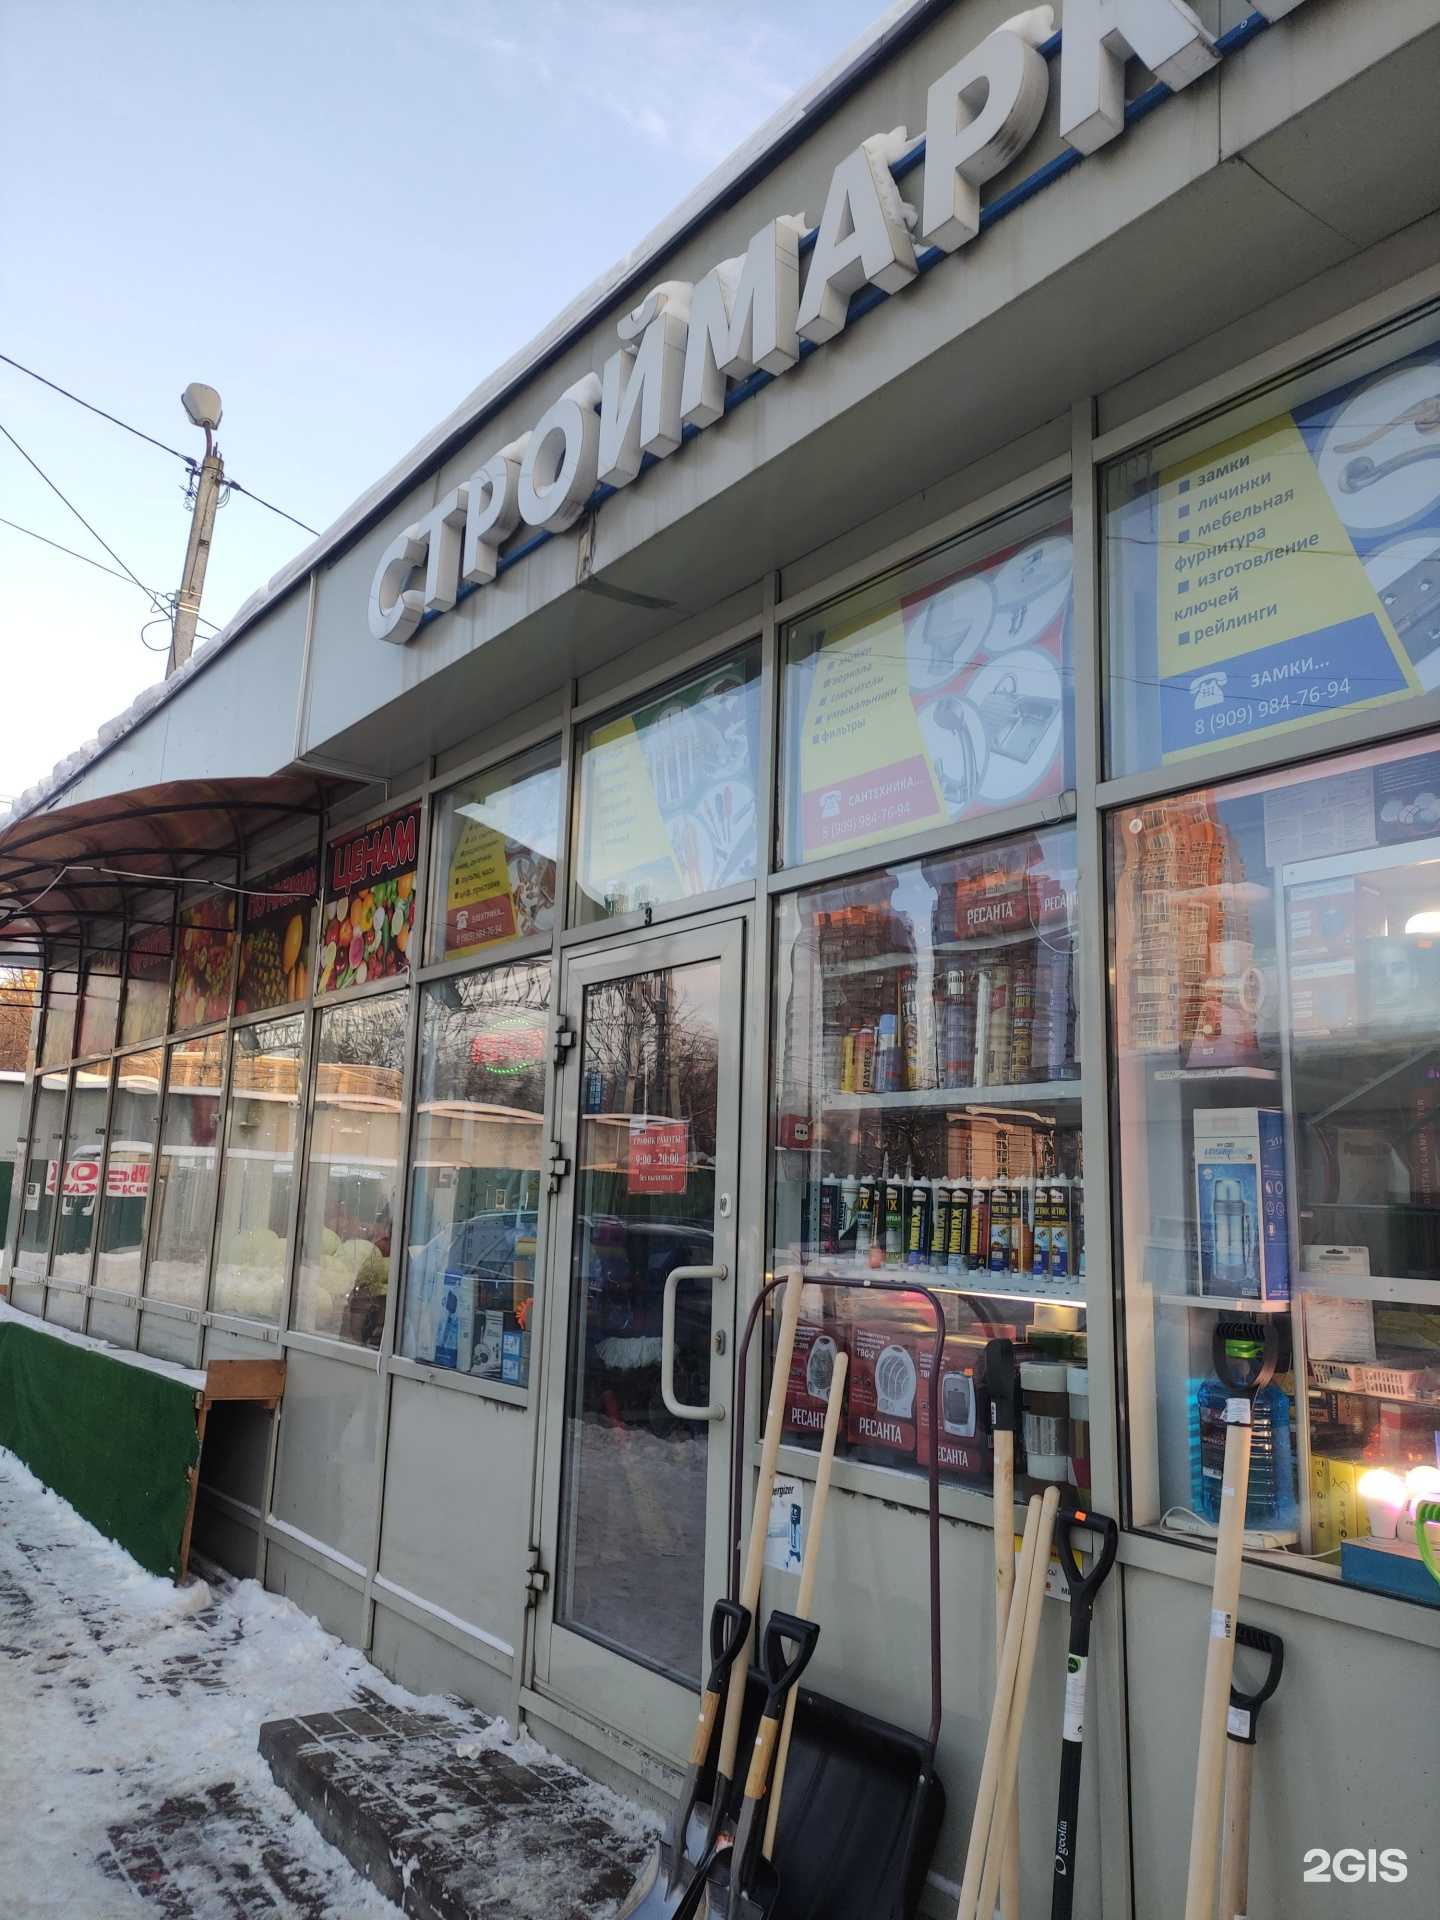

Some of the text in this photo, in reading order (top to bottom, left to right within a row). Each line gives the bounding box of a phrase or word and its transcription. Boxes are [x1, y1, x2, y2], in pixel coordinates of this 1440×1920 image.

[368, 0, 1306, 645] СТРОЙМАРК
[1198, 455, 1250, 486] замки
[1197, 472, 1271, 512] личинки
[1198, 489, 1294, 536] мебельная
[1174, 527, 1266, 573] фурнитура
[1198, 533, 1320, 587] изготовление
[1174, 585, 1239, 622] ключей
[1194, 603, 1278, 644] рейлинги
[1194, 677, 1351, 735] 8 (909) 984-76-94
[821, 719, 866, 744] фильтры
[333, 815, 416, 895] ЦЕНАМ
[967, 901, 1013, 926] РЕСАНТА
[658, 1152, 679, 1165] 20:00
[948, 1208, 962, 1253] МОНТАЖ
[791, 1407, 826, 1429] РЕСАНТ
[859, 1417, 902, 1443] РЕСАНТА
[937, 1446, 968, 1467] ЕСАНТА
[1057, 1820, 1068, 1857] geolia
